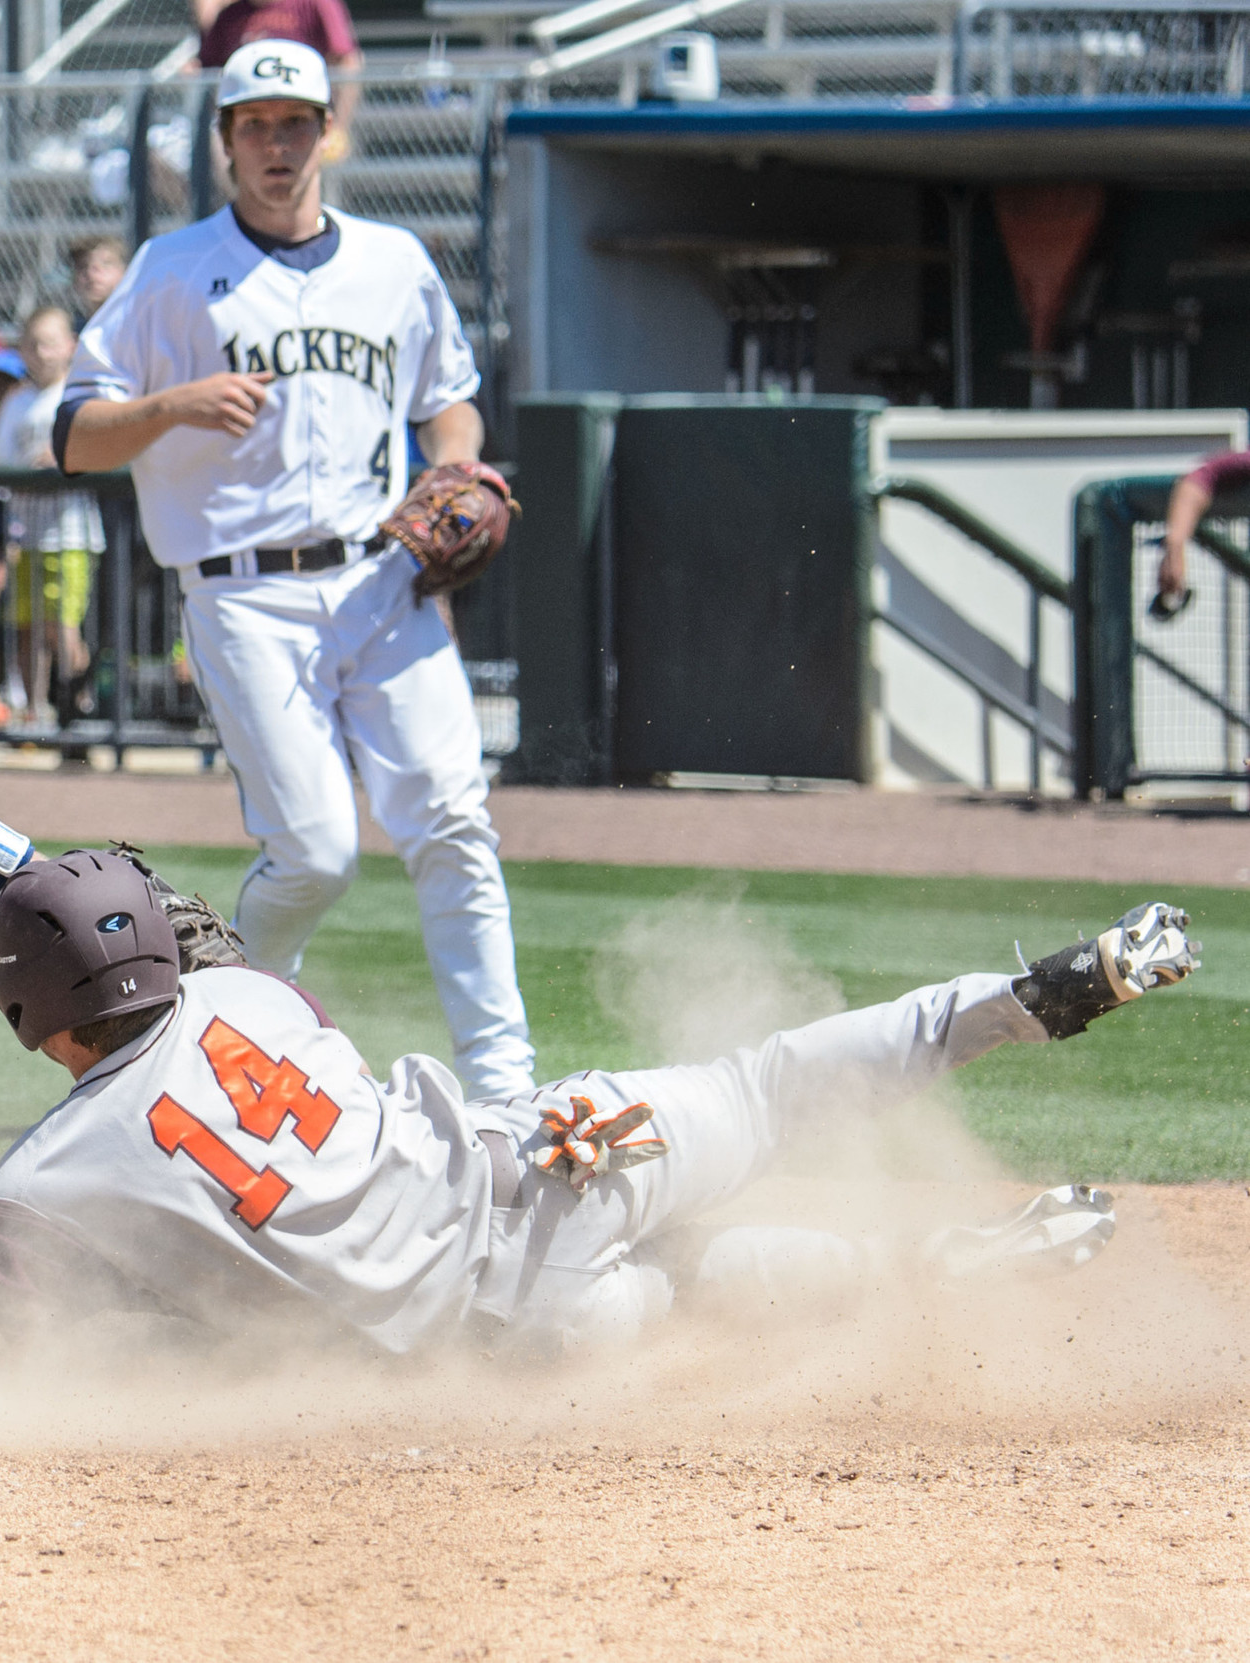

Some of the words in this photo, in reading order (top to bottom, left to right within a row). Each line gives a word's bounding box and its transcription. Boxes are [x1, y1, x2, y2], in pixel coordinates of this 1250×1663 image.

[253, 56, 301, 85] GT
[368, 429, 391, 498] 4
[120, 977, 137, 995] 14
[146, 1014, 343, 1233] 14
